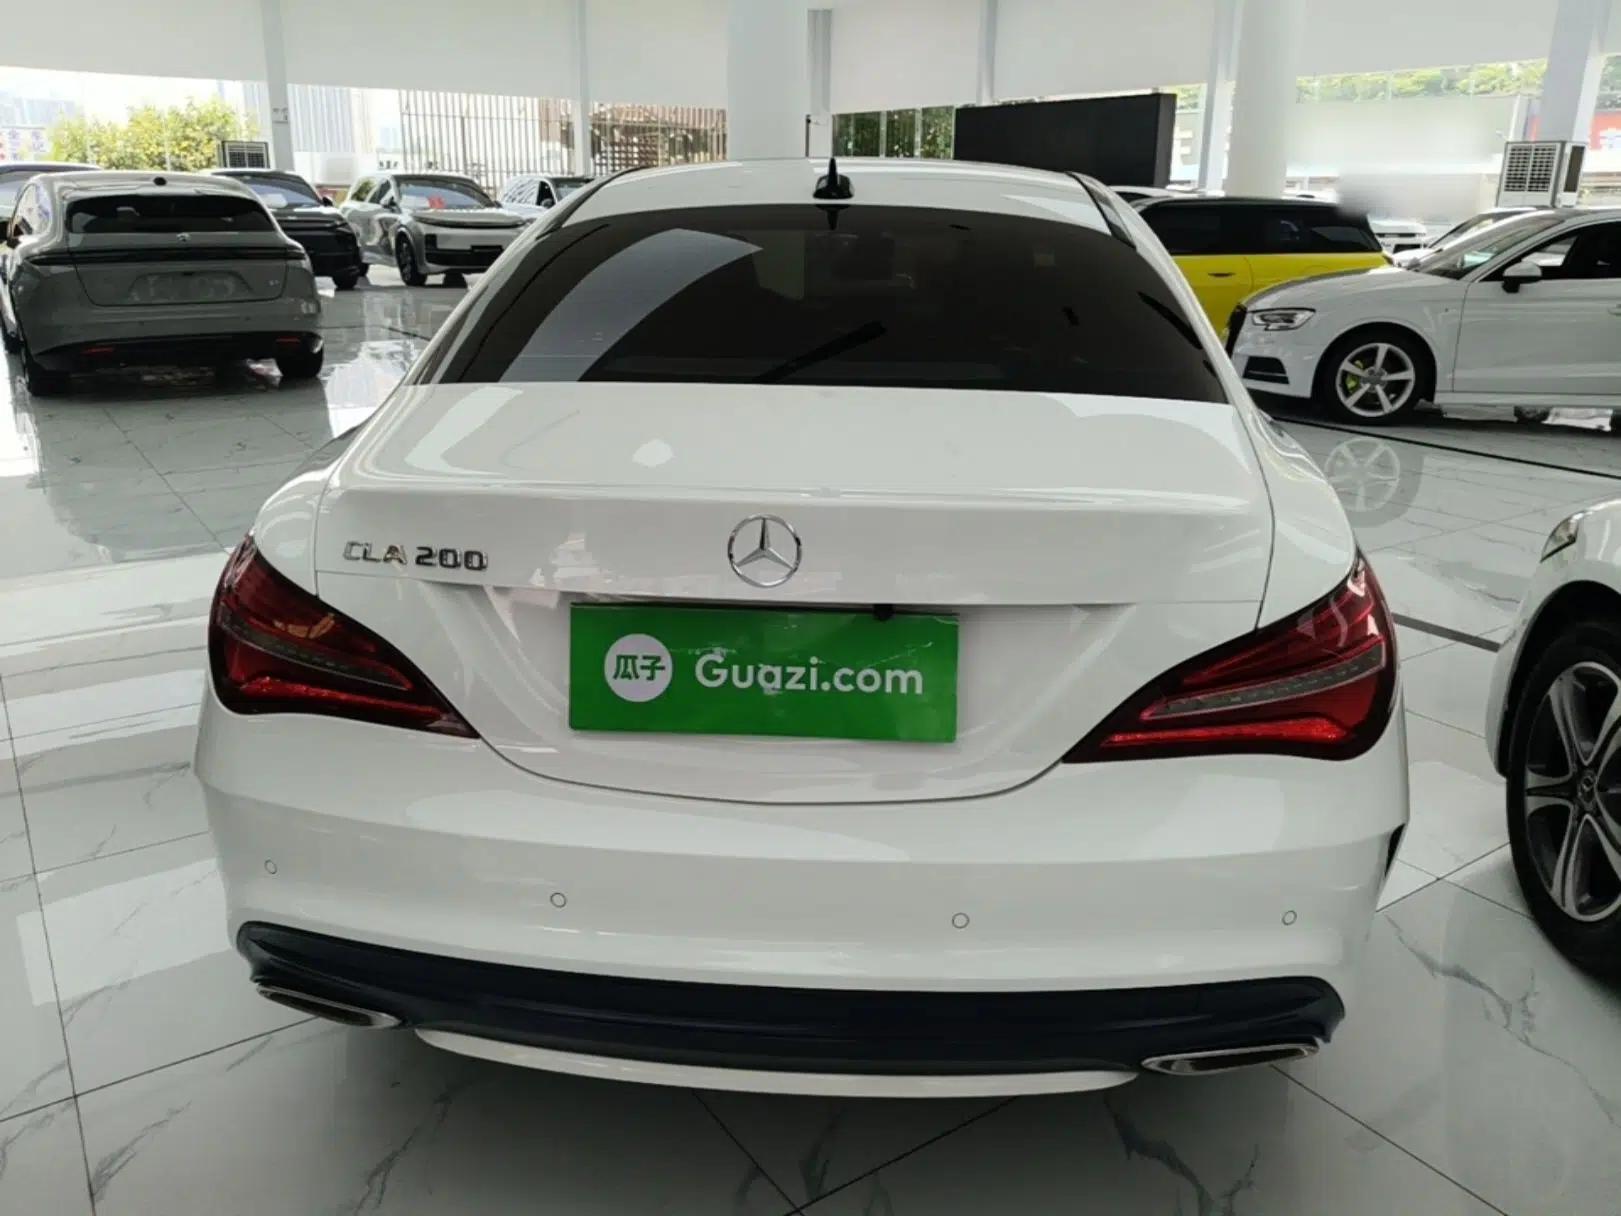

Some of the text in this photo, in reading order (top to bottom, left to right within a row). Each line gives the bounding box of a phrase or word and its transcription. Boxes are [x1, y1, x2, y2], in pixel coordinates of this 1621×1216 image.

[343, 541, 489, 571] CLA 200
[612, 653, 667, 682] 瓜子
[695, 653, 924, 696] Guazi.com
